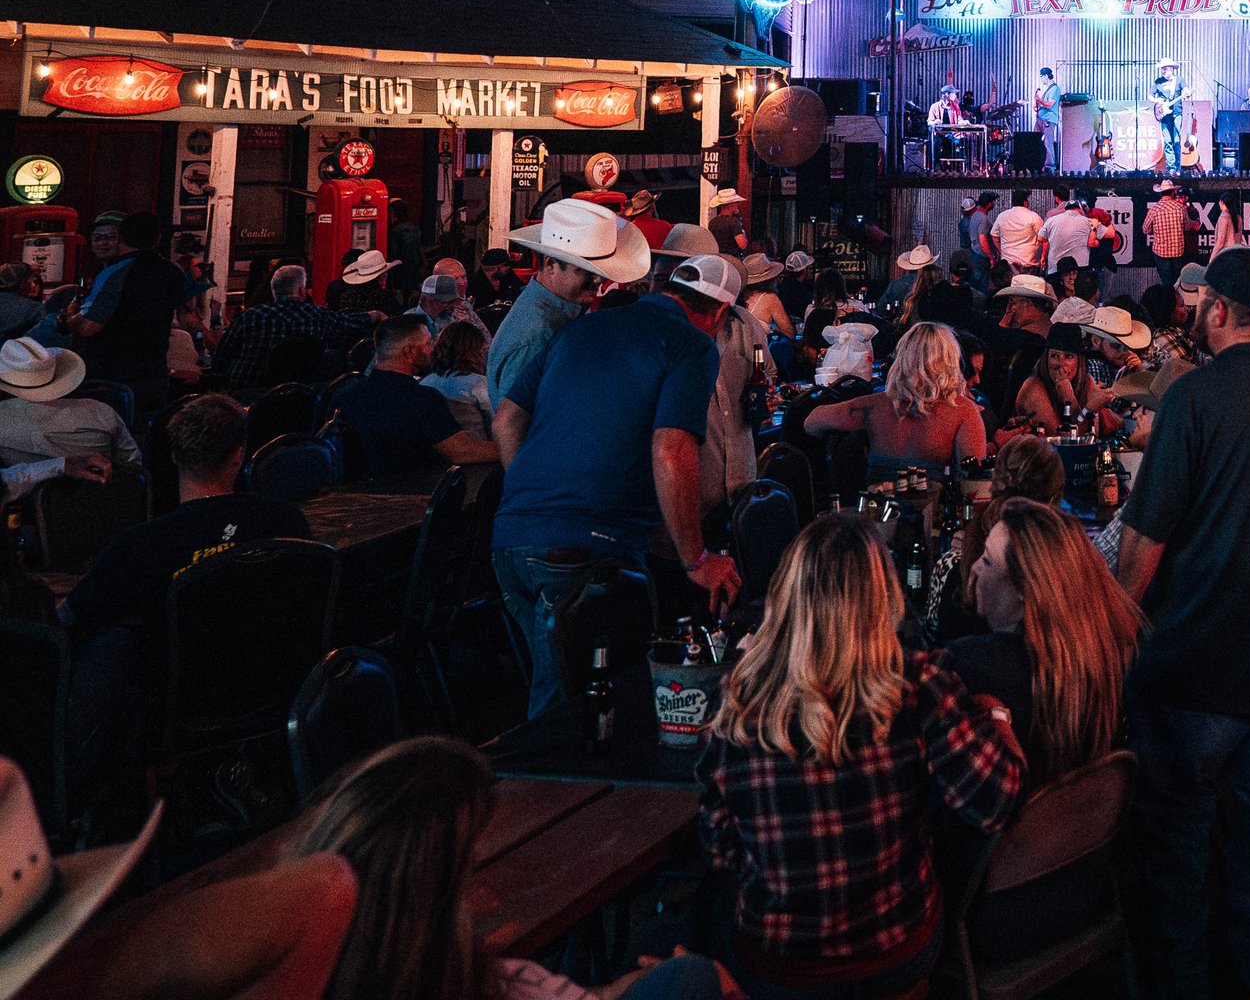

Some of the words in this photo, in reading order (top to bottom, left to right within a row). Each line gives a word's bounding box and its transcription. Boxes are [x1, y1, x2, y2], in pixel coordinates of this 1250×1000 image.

[958, 2, 985, 17] At
[920, 32, 973, 49] LIGHT
[202, 66, 321, 112] TARA'S
[343, 74, 413, 115] FOOD
[436, 78, 542, 118] MARKET
[1117, 125, 1157, 138] LONE
[1115, 138, 1159, 151] STAR
[513, 171, 537, 179] MOTOR
[24, 185, 53, 193] DIESEL
[27, 192, 48, 200] FUEL
[1107, 210, 1131, 226] ite
[658, 692, 701, 713] Shiner
[663, 713, 694, 723] BEERS
